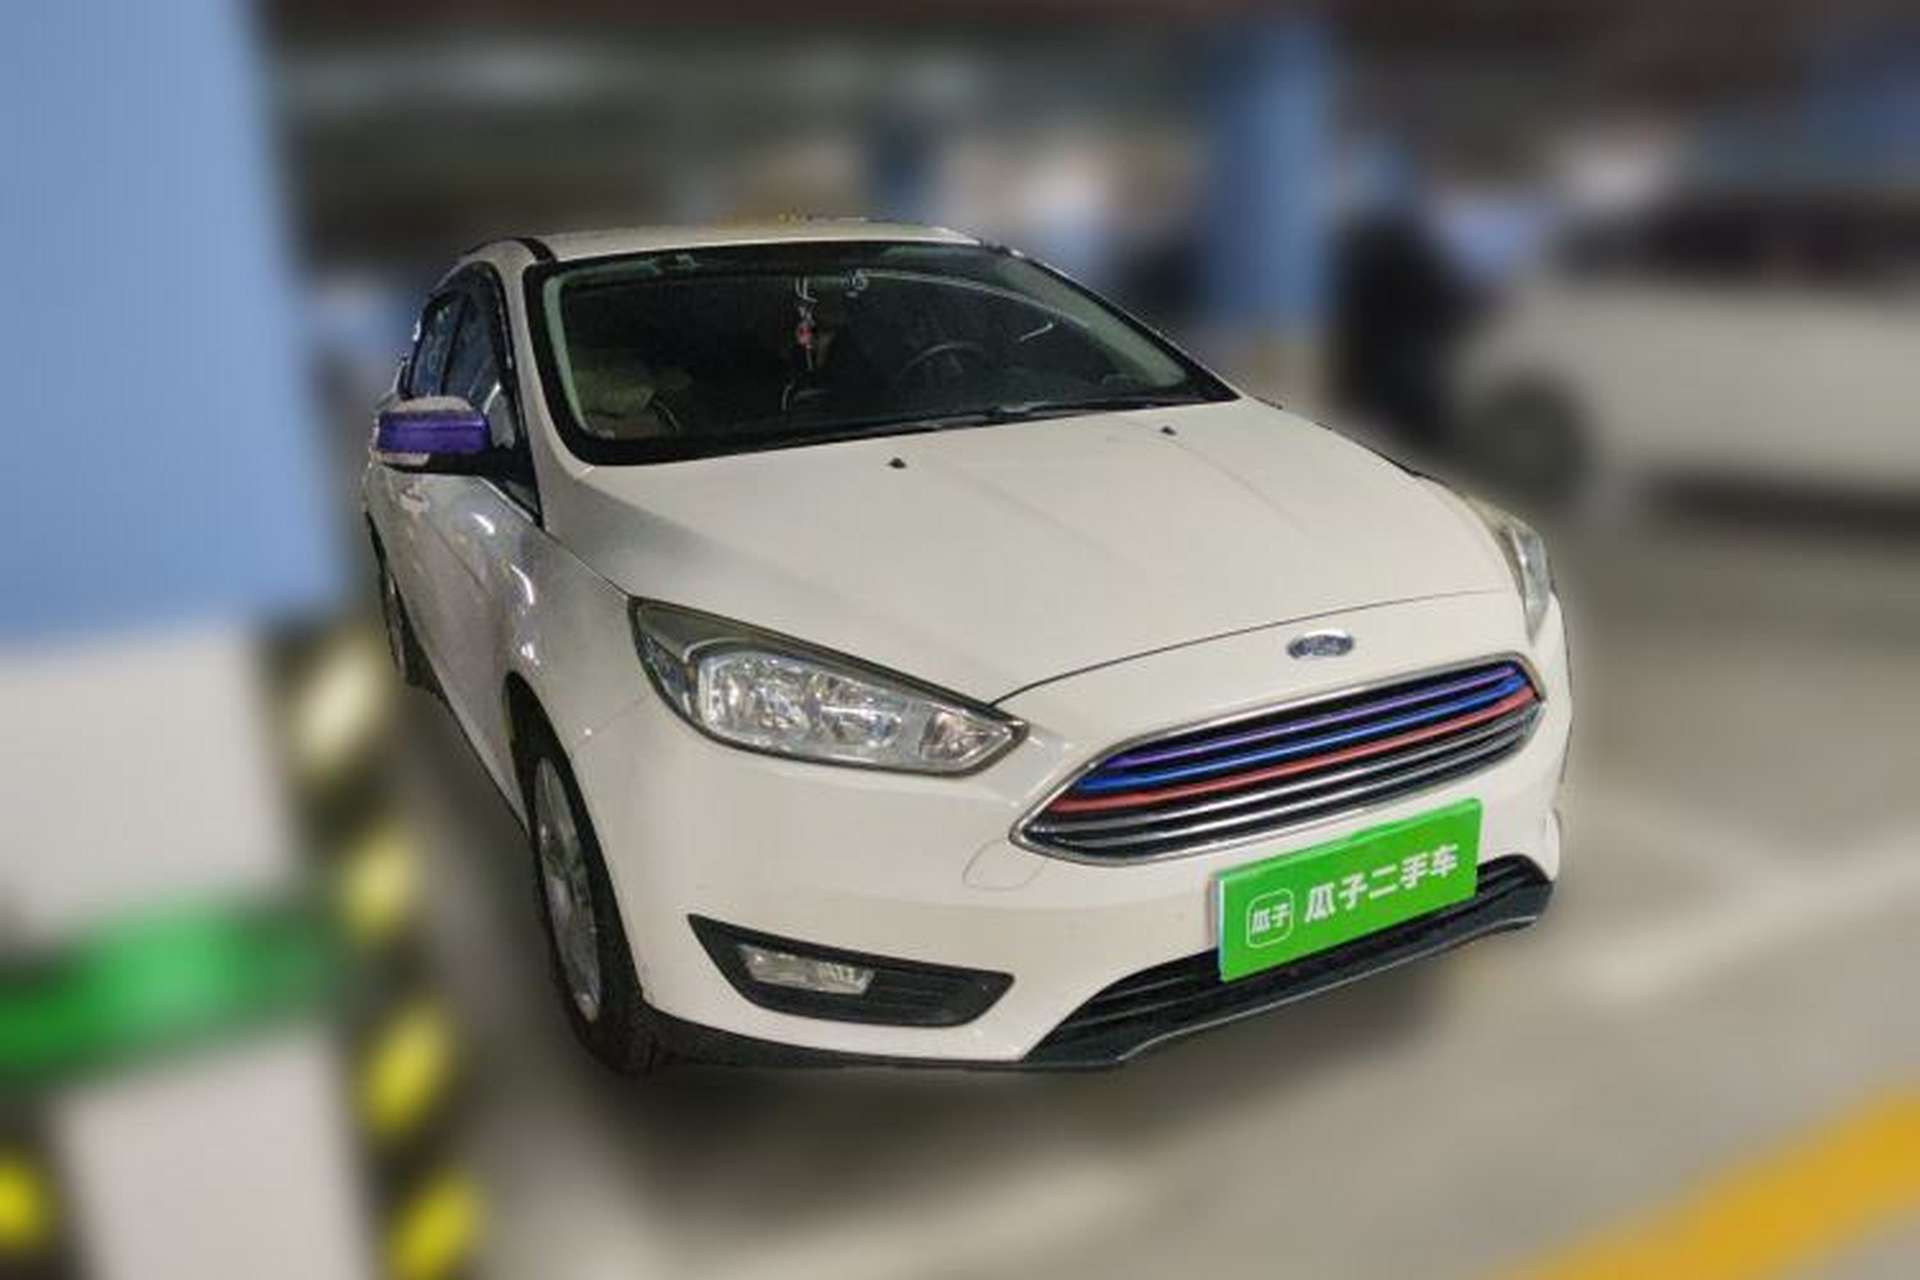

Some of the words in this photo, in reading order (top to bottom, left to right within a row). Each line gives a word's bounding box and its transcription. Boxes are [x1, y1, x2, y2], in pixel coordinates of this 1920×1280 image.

[1304, 843, 1459, 923] 瓜子二手车
[1250, 902, 1291, 934] 瓜子
